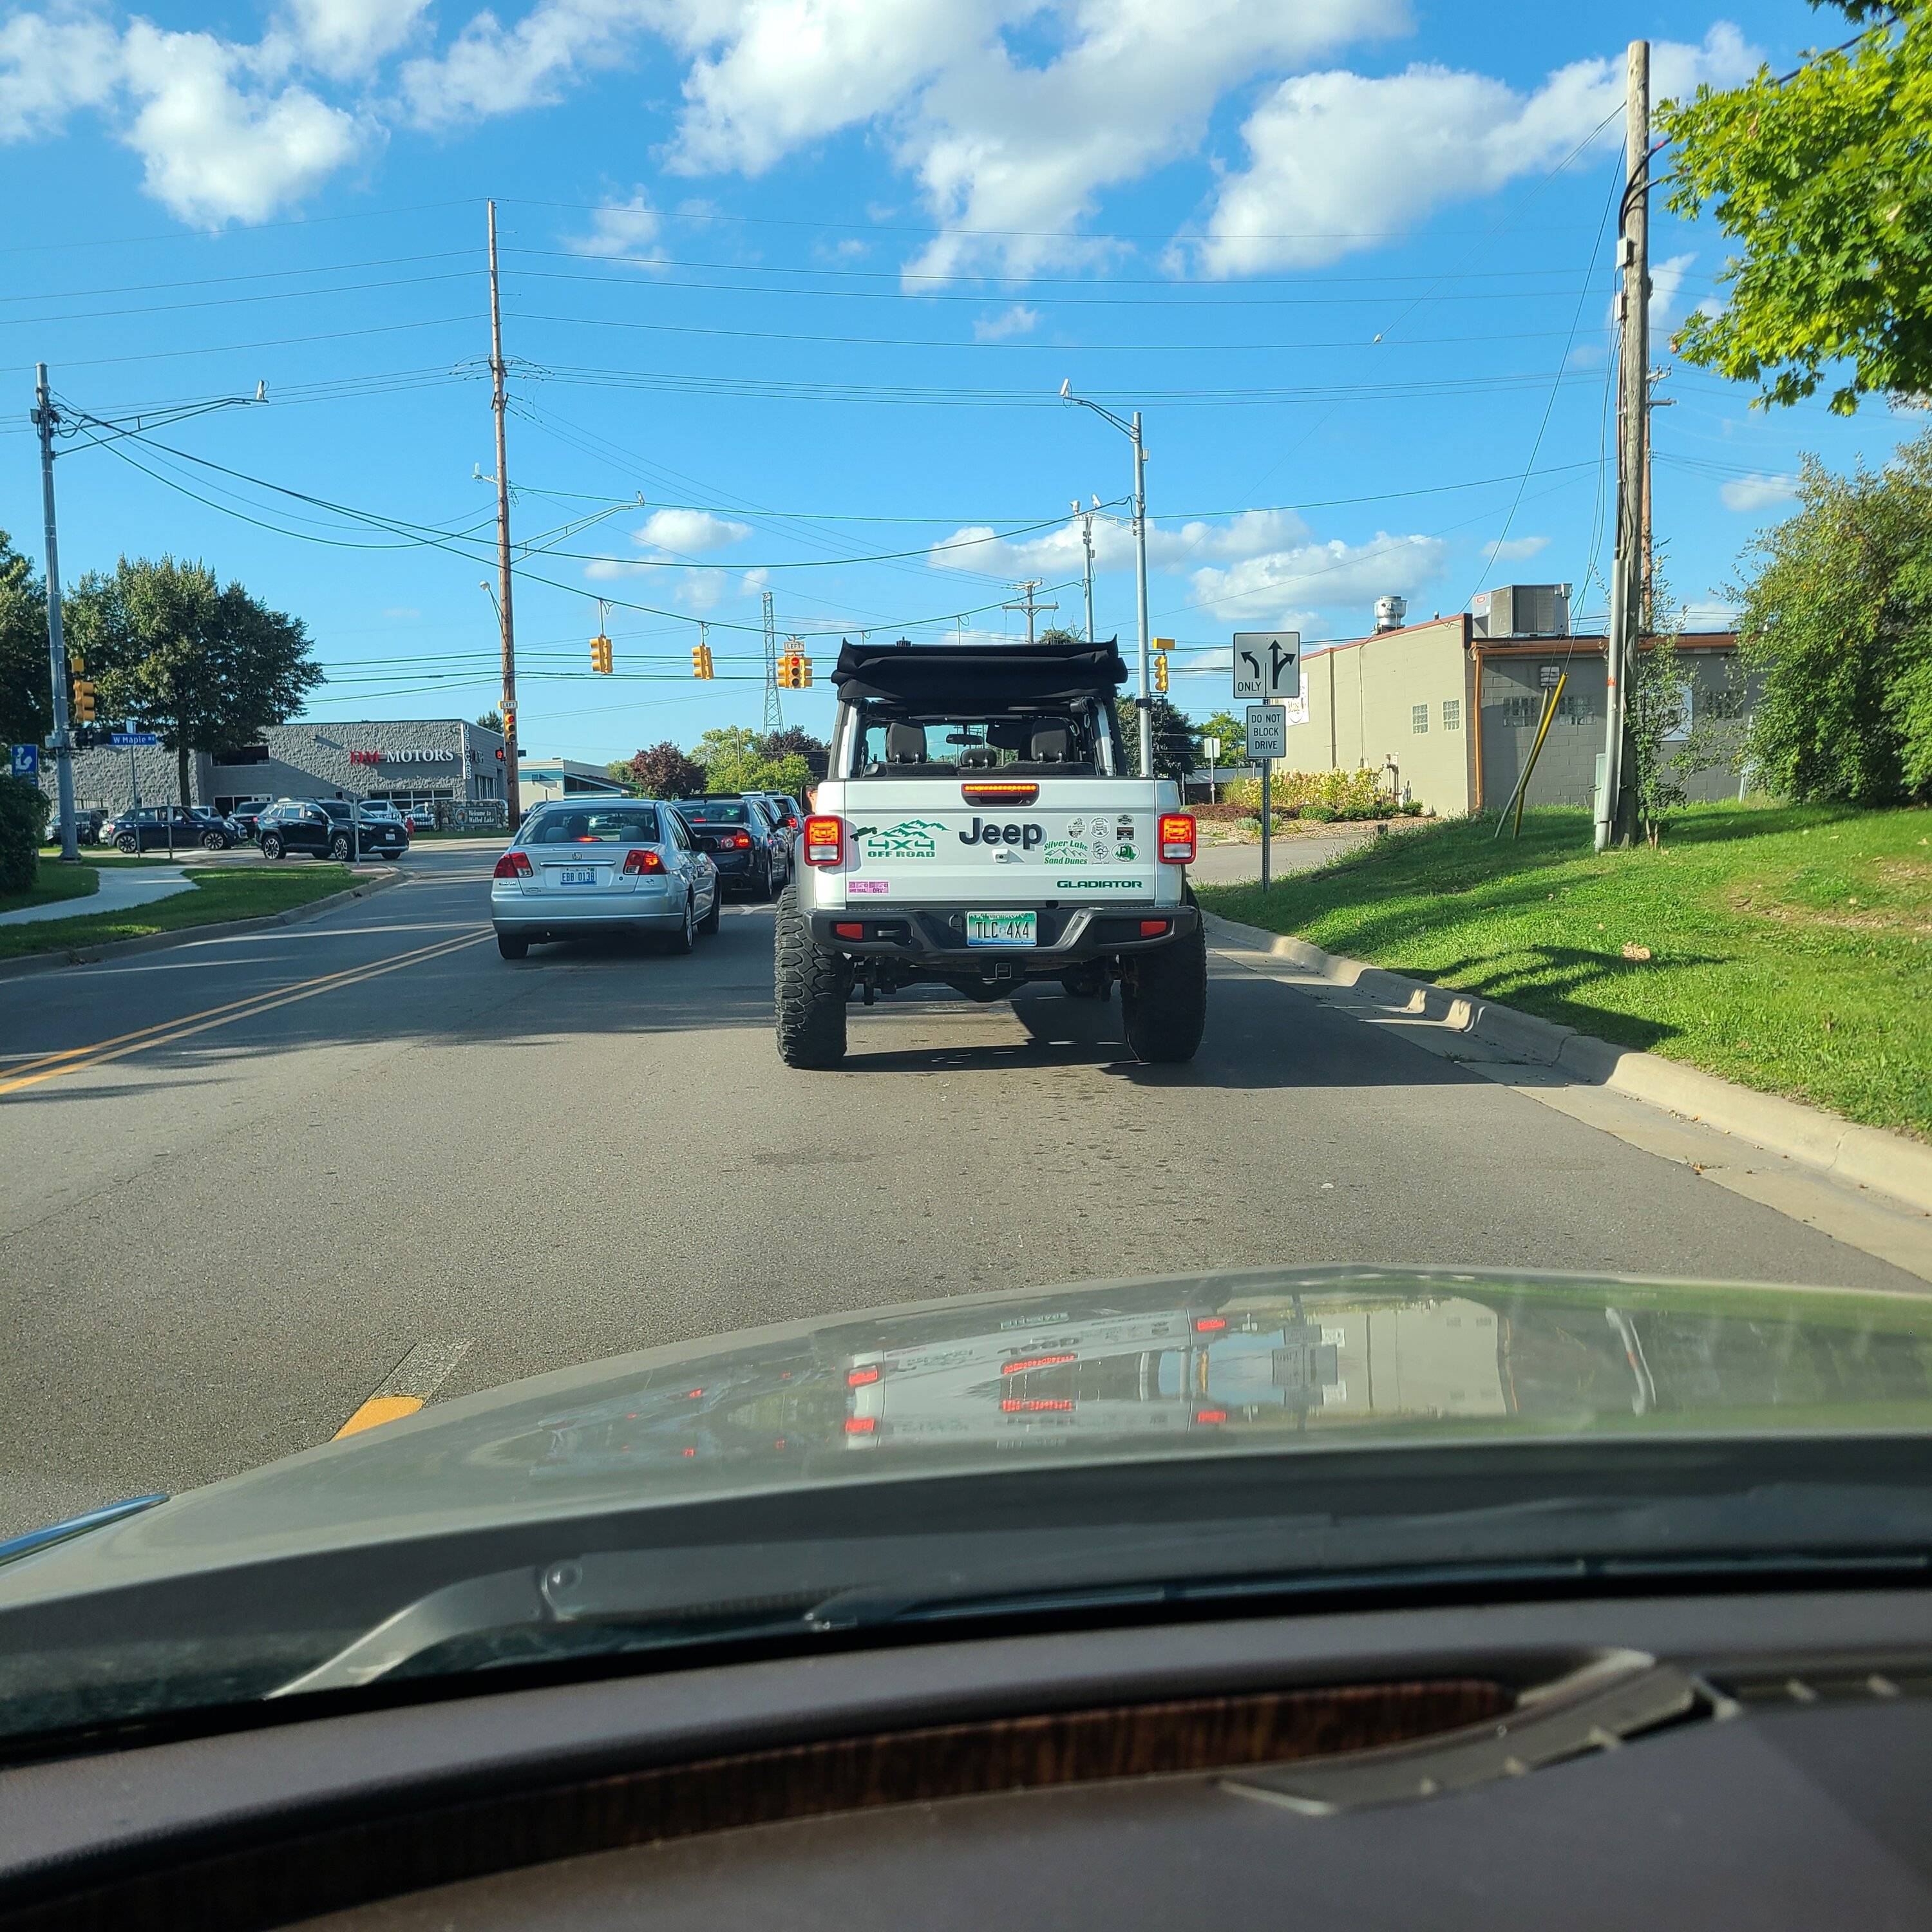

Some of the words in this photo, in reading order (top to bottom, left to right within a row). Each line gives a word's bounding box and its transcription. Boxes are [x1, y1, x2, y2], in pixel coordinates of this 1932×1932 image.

[1238, 682, 1262, 692] ONLY
[1251, 714, 1262, 723] DO
[1266, 714, 1281, 723] NOT
[1253, 728, 1279, 736] BLOCK
[1255, 741, 1278, 749] DRIVE
[386, 750, 454, 763] MOTORS
[958, 817, 1043, 850] Jeep
[1043, 840, 1068, 851] Silver
[1070, 840, 1088, 851] Lake
[1044, 857, 1063, 865] Sand
[976, 922, 998, 938] TLC
[1006, 922, 1028, 938] 4X4
